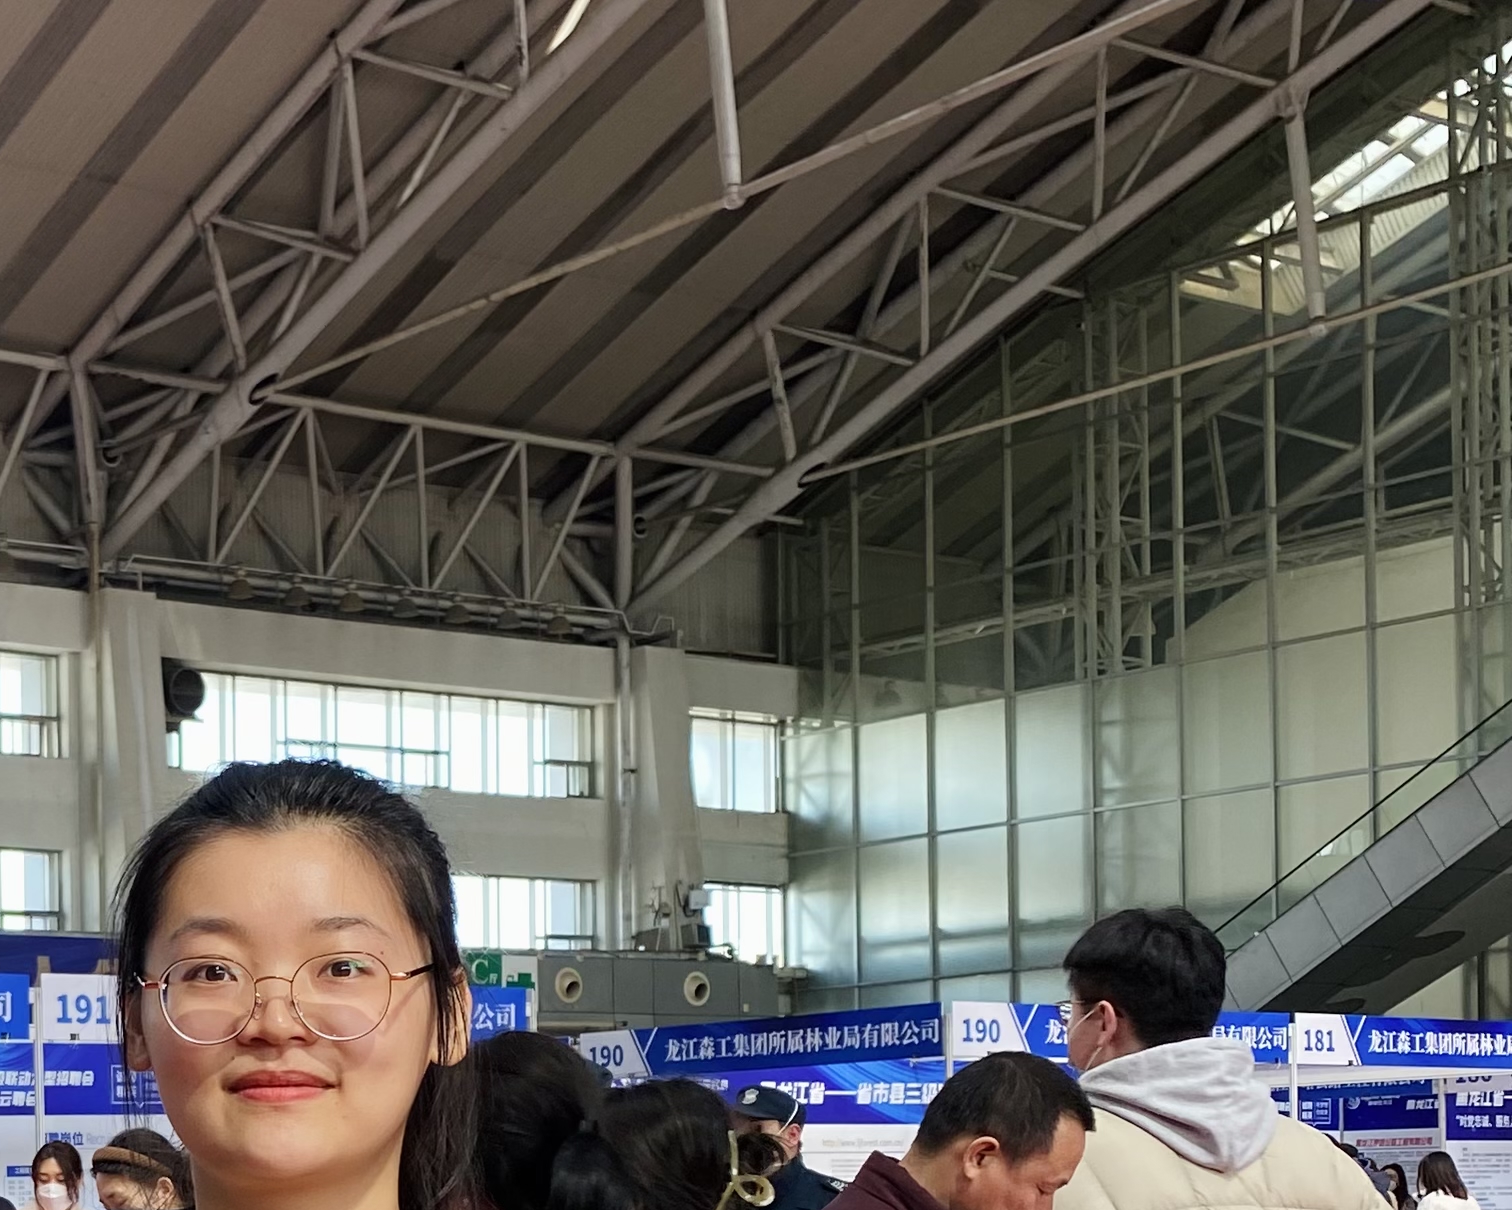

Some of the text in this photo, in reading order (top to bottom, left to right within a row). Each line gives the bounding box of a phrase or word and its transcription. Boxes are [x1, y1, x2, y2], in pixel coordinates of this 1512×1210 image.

[55, 993, 110, 1025] 191
[665, 1018, 940, 1063] 龙江森工集团所属林业局有限公司
[962, 1018, 1000, 1043] 190
[1304, 1029, 1335, 1052] 181
[589, 1045, 624, 1067] 190
